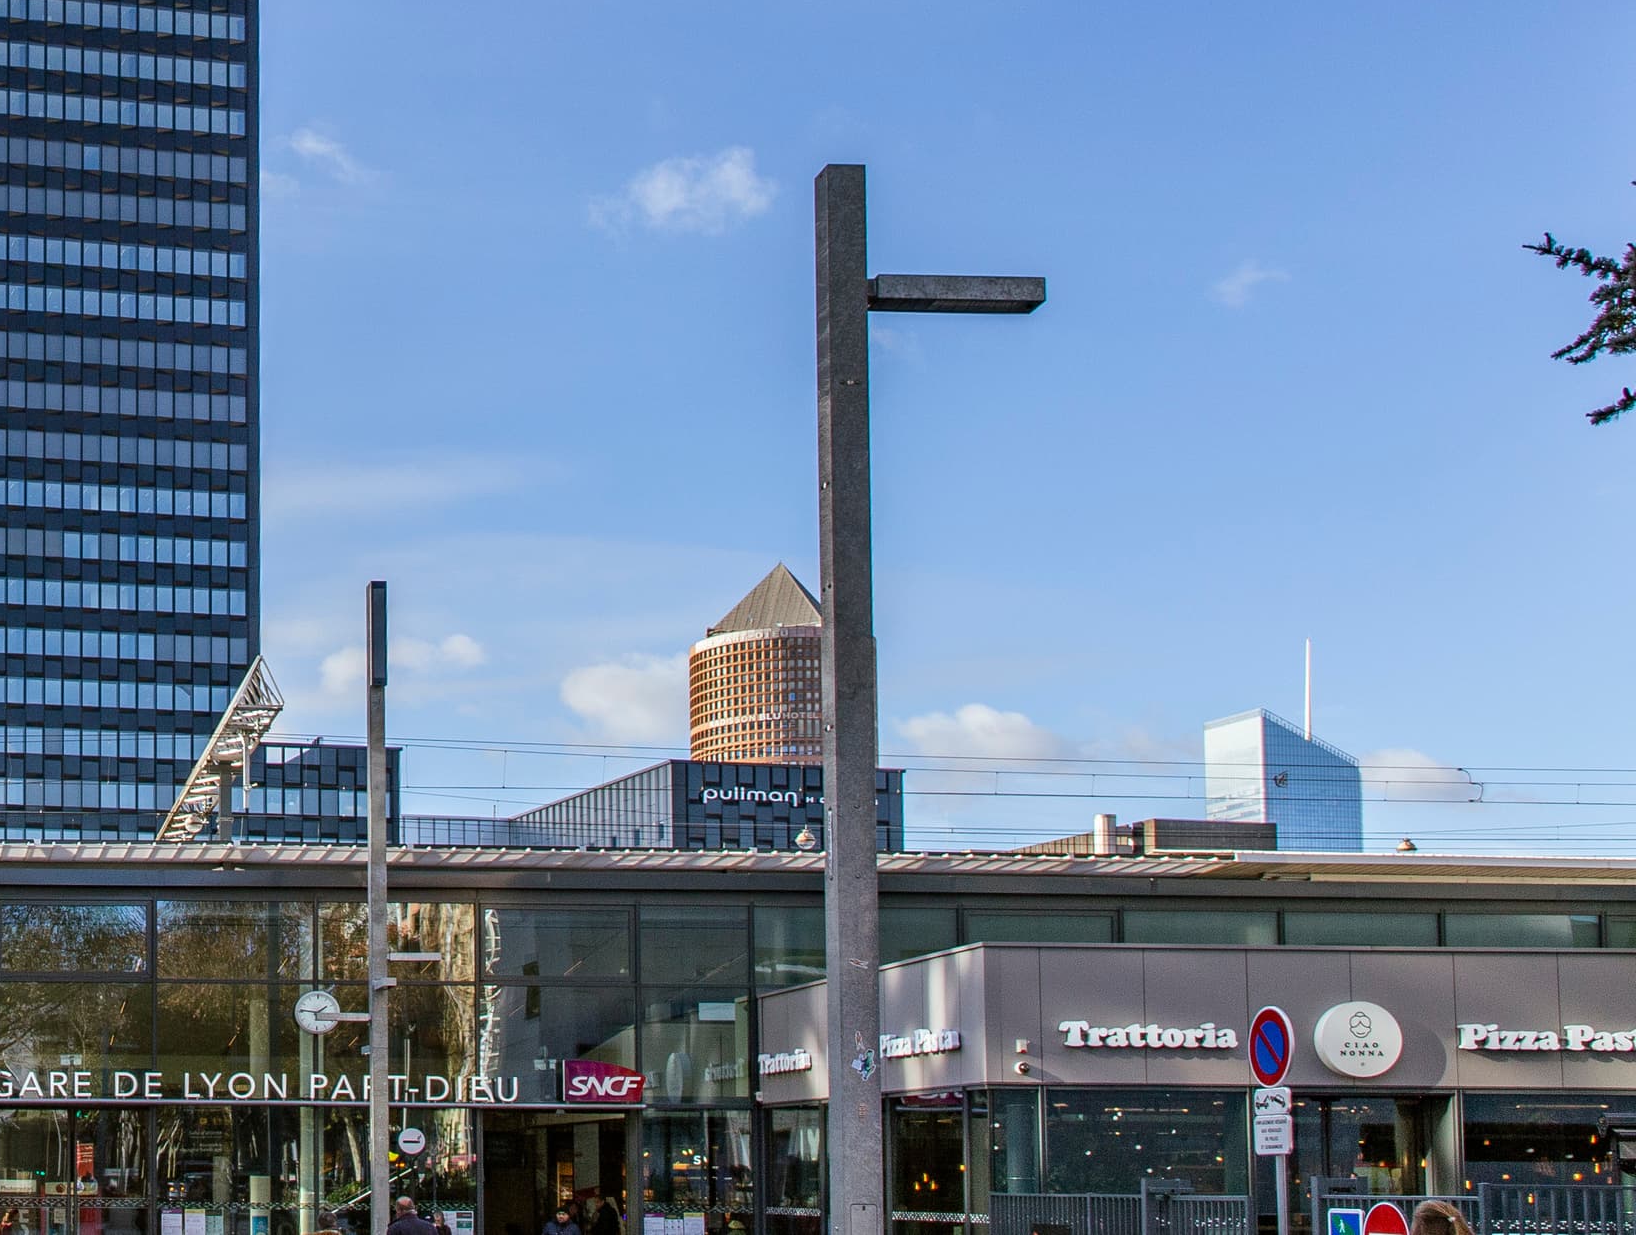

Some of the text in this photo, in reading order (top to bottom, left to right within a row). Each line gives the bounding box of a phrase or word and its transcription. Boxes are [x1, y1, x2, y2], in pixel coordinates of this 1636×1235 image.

[758, 712, 781, 721] BLU
[783, 712, 819, 720] HOTEL
[702, 786, 799, 807] pullman
[880, 1029, 961, 1058] Pizza Pasta
[1059, 1020, 1239, 1048] Trattoria
[1457, 1024, 1561, 1051] Pizza
[758, 1048, 812, 1076] Trattoria
[114, 1072, 163, 1098] DE
[184, 1072, 287, 1099] LYON
[568, 1076, 641, 1096] SNCF
